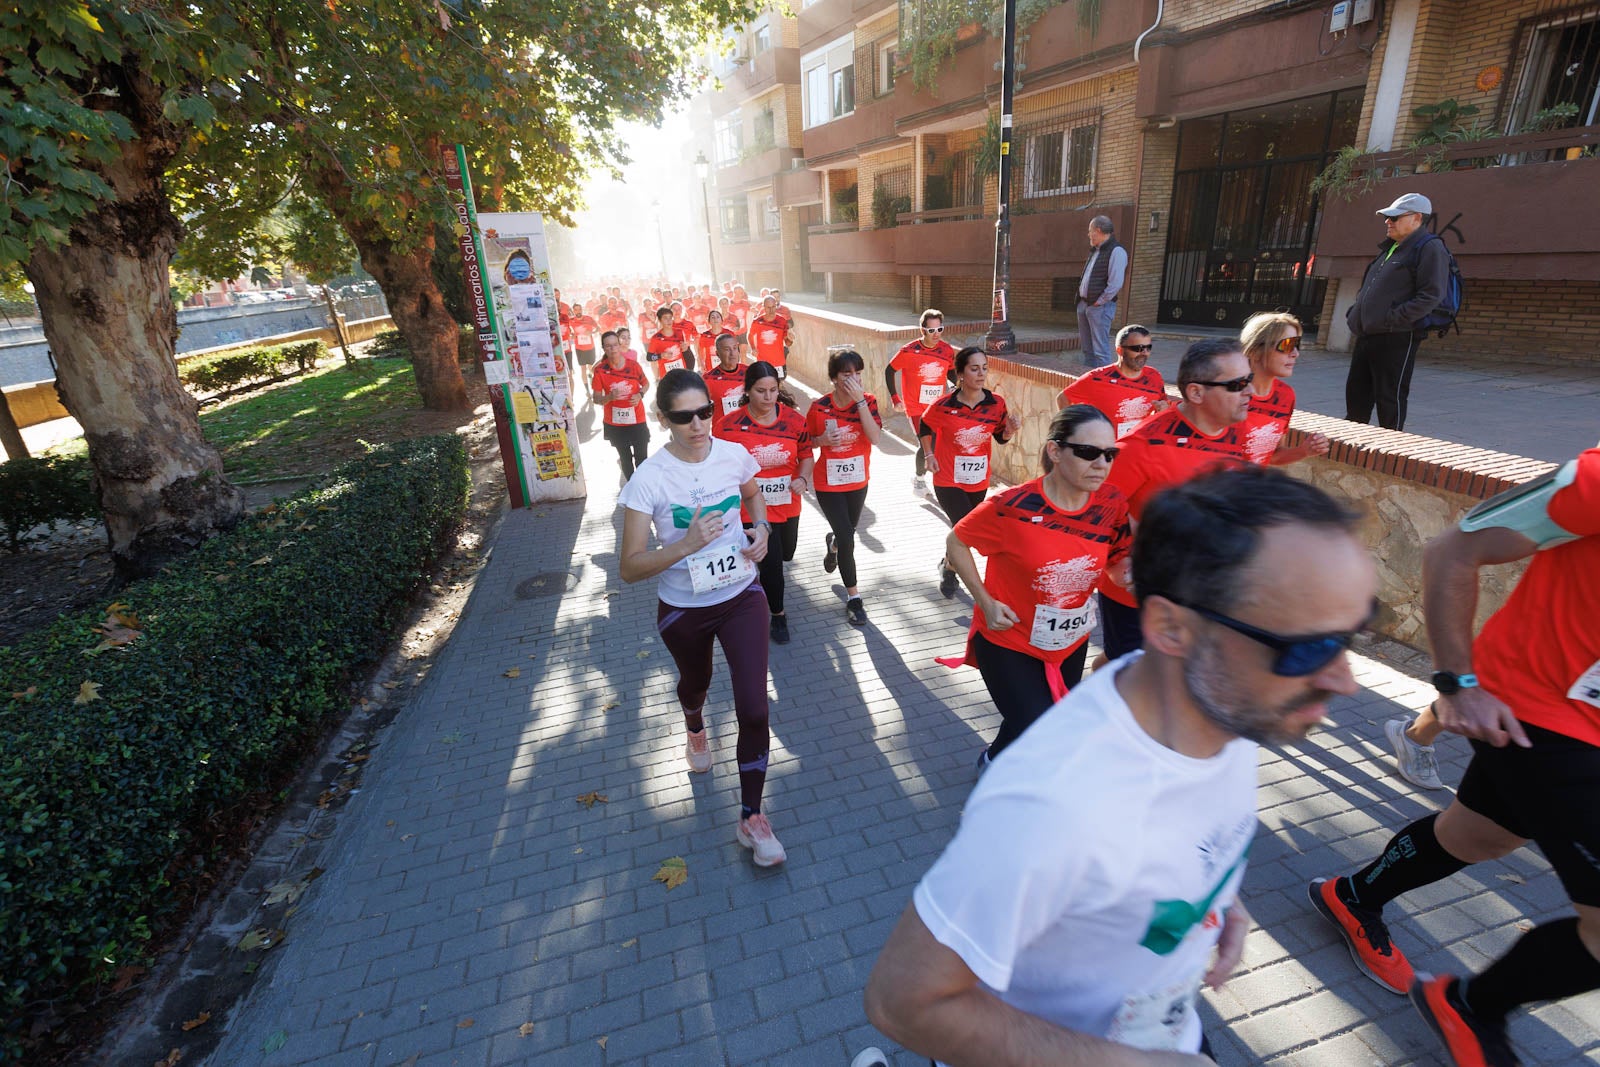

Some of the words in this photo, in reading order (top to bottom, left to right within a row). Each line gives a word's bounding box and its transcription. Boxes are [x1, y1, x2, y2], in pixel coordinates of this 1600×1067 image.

[468, 264, 490, 328] tinerarios
[836, 463, 855, 473] 763
[961, 462, 985, 472] 1724
[759, 483, 785, 493] 1629
[706, 555, 736, 576] 112
[1047, 611, 1089, 631] 1490
